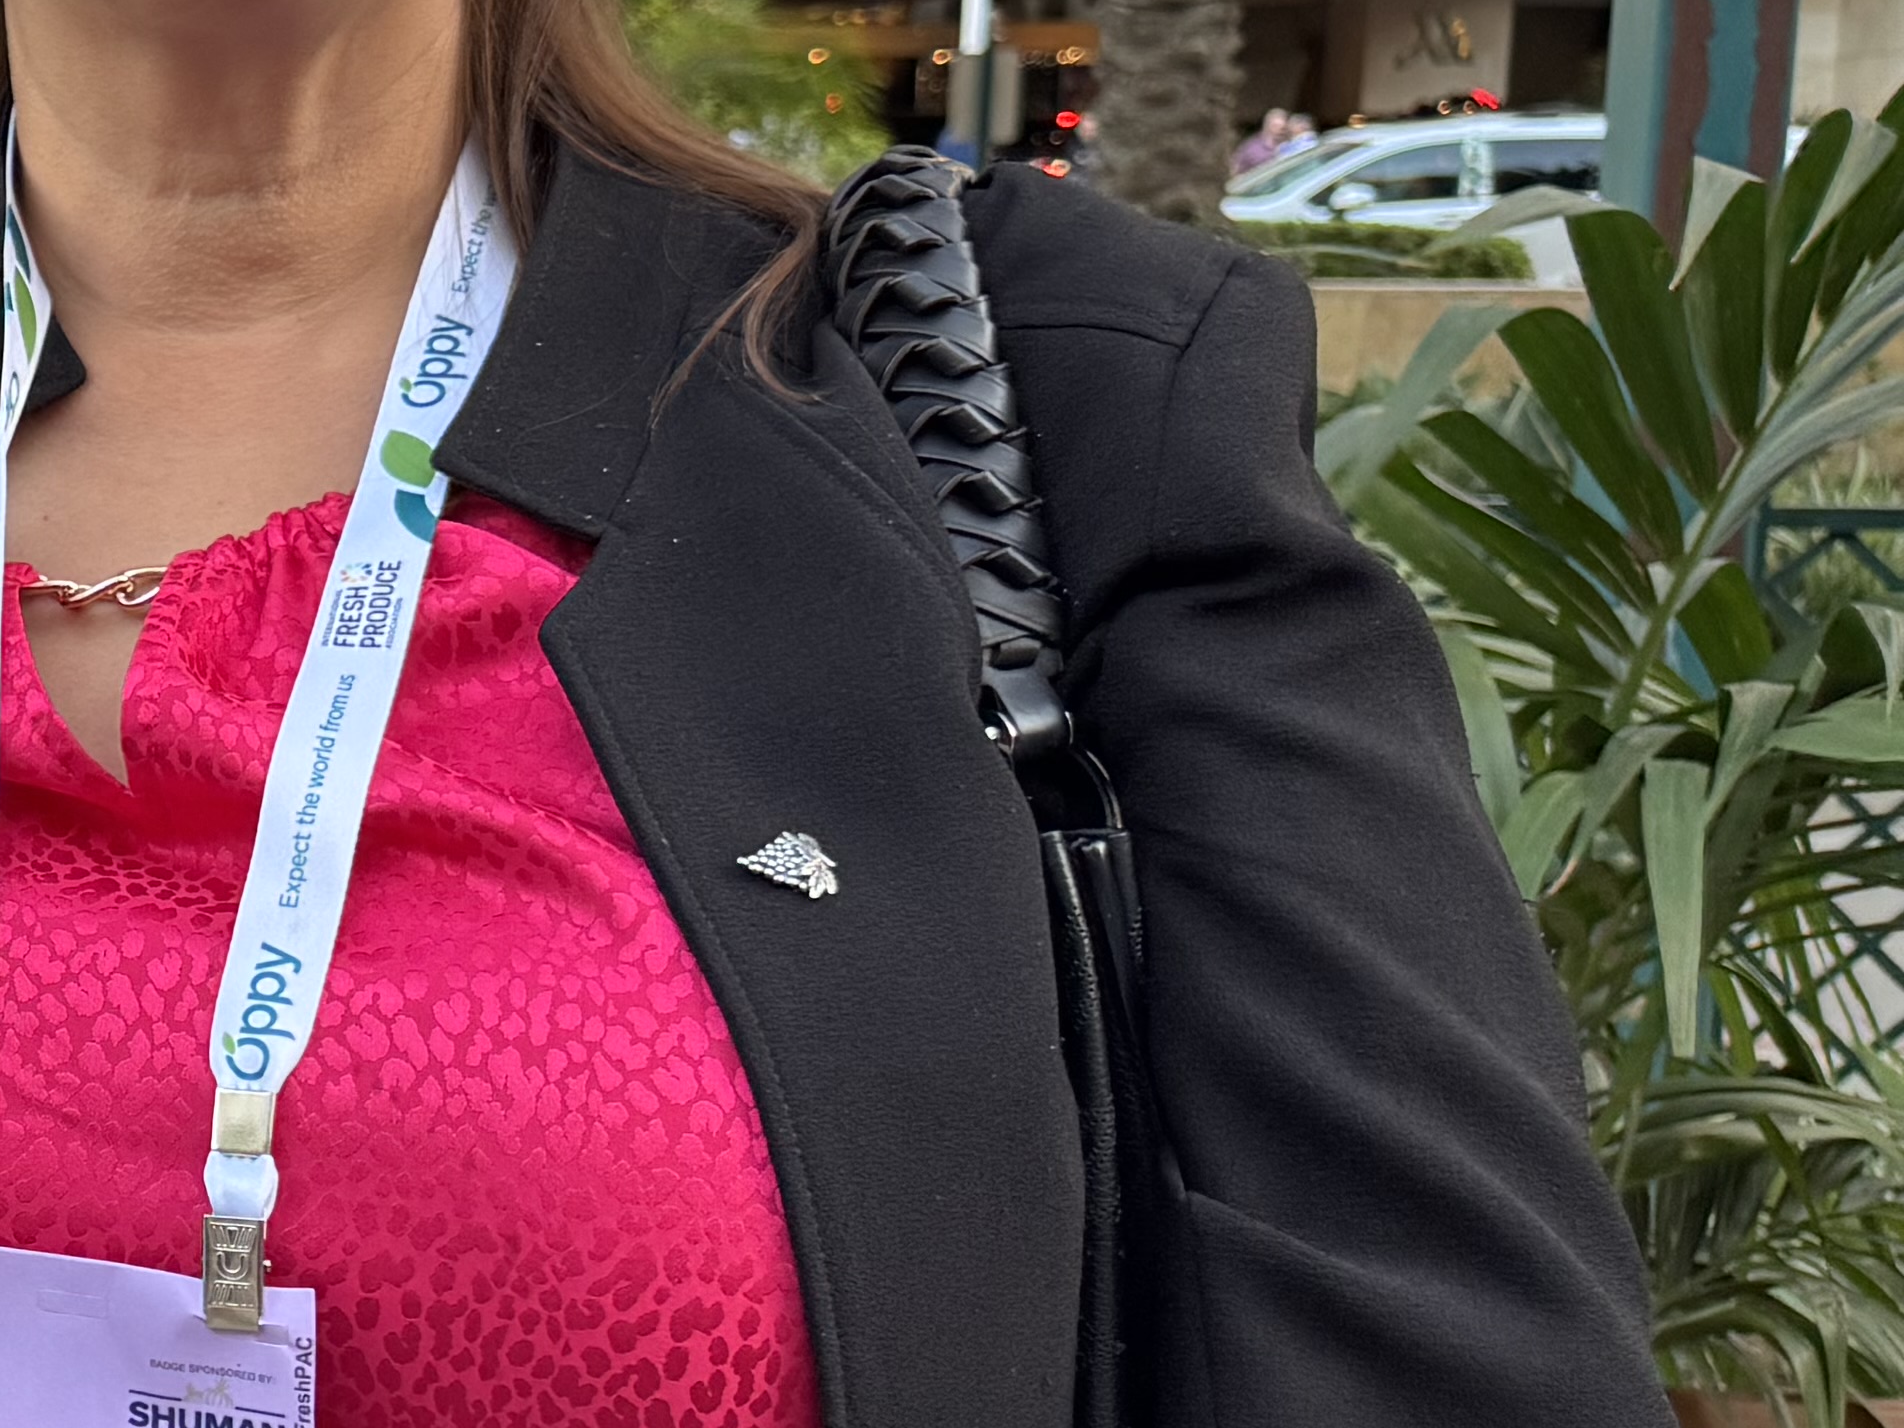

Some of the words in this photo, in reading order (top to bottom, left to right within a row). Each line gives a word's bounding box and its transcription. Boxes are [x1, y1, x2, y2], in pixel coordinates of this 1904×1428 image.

[451, 238, 483, 294] Expect
[399, 314, 475, 409] Oppy
[331, 585, 370, 649] FRESH
[359, 559, 403, 650] PRODUCE
[336, 674, 357, 694] us
[318, 695, 349, 734] from
[307, 734, 337, 791] world
[299, 790, 321, 826] the
[279, 830, 313, 909] Expect
[225, 942, 302, 1082] Oppy
[149, 1358, 186, 1373] BADGE
[188, 1363, 256, 1382] SPONSORED
